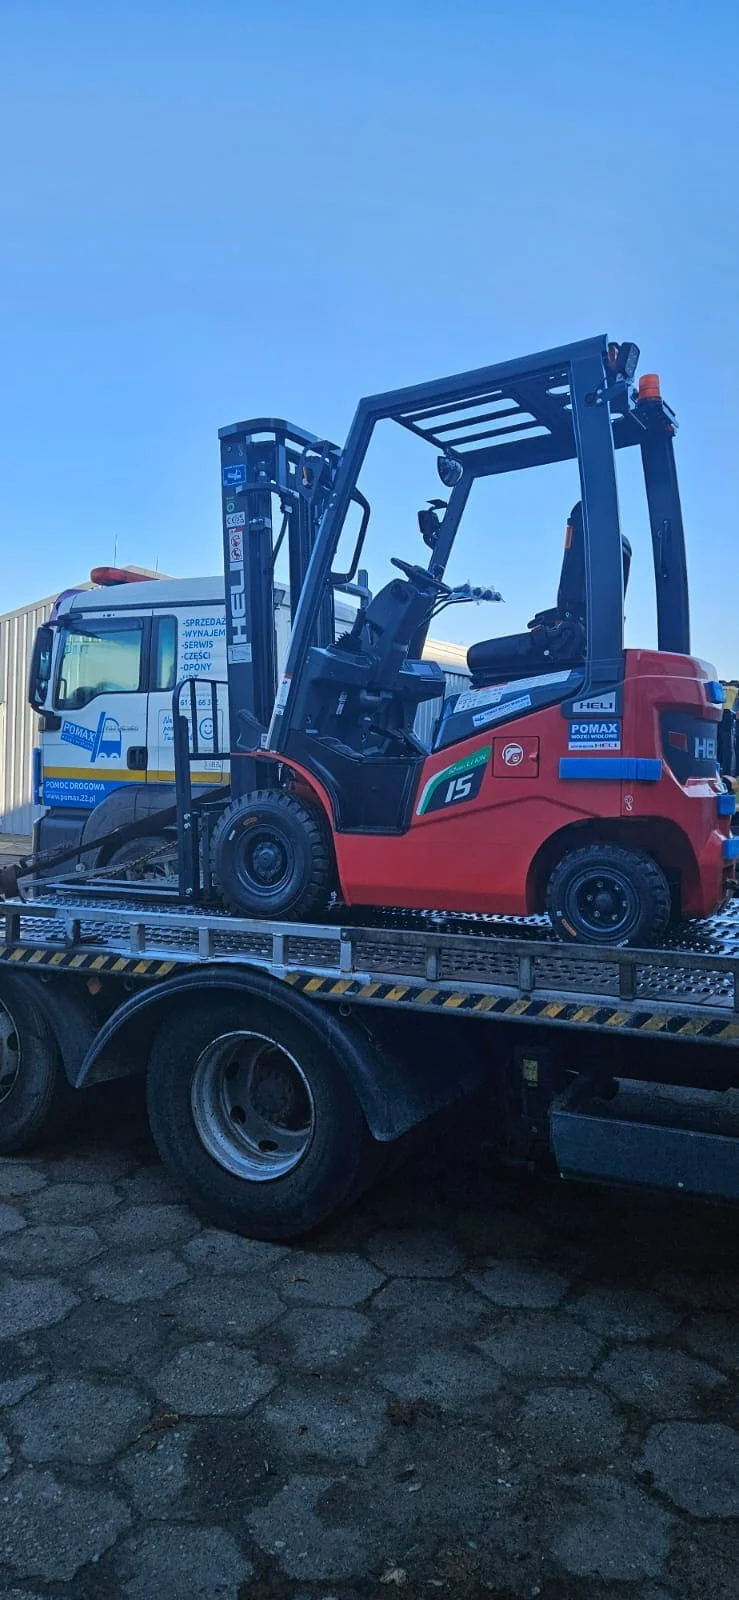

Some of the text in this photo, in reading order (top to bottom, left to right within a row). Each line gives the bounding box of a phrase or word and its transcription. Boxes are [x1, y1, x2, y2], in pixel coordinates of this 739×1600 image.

[229, 561, 247, 644] HELI
[182, 629, 226, 638] -WYNAJEM
[181, 640, 214, 649] -SERWIS
[180, 663, 213, 671] -OPONY
[579, 702, 613, 710] HELI
[63, 722, 96, 743] POMAX
[571, 723, 618, 734] POMAX
[45, 781, 106, 791] POMOC DROGOWA
[445, 773, 475, 803] 15
